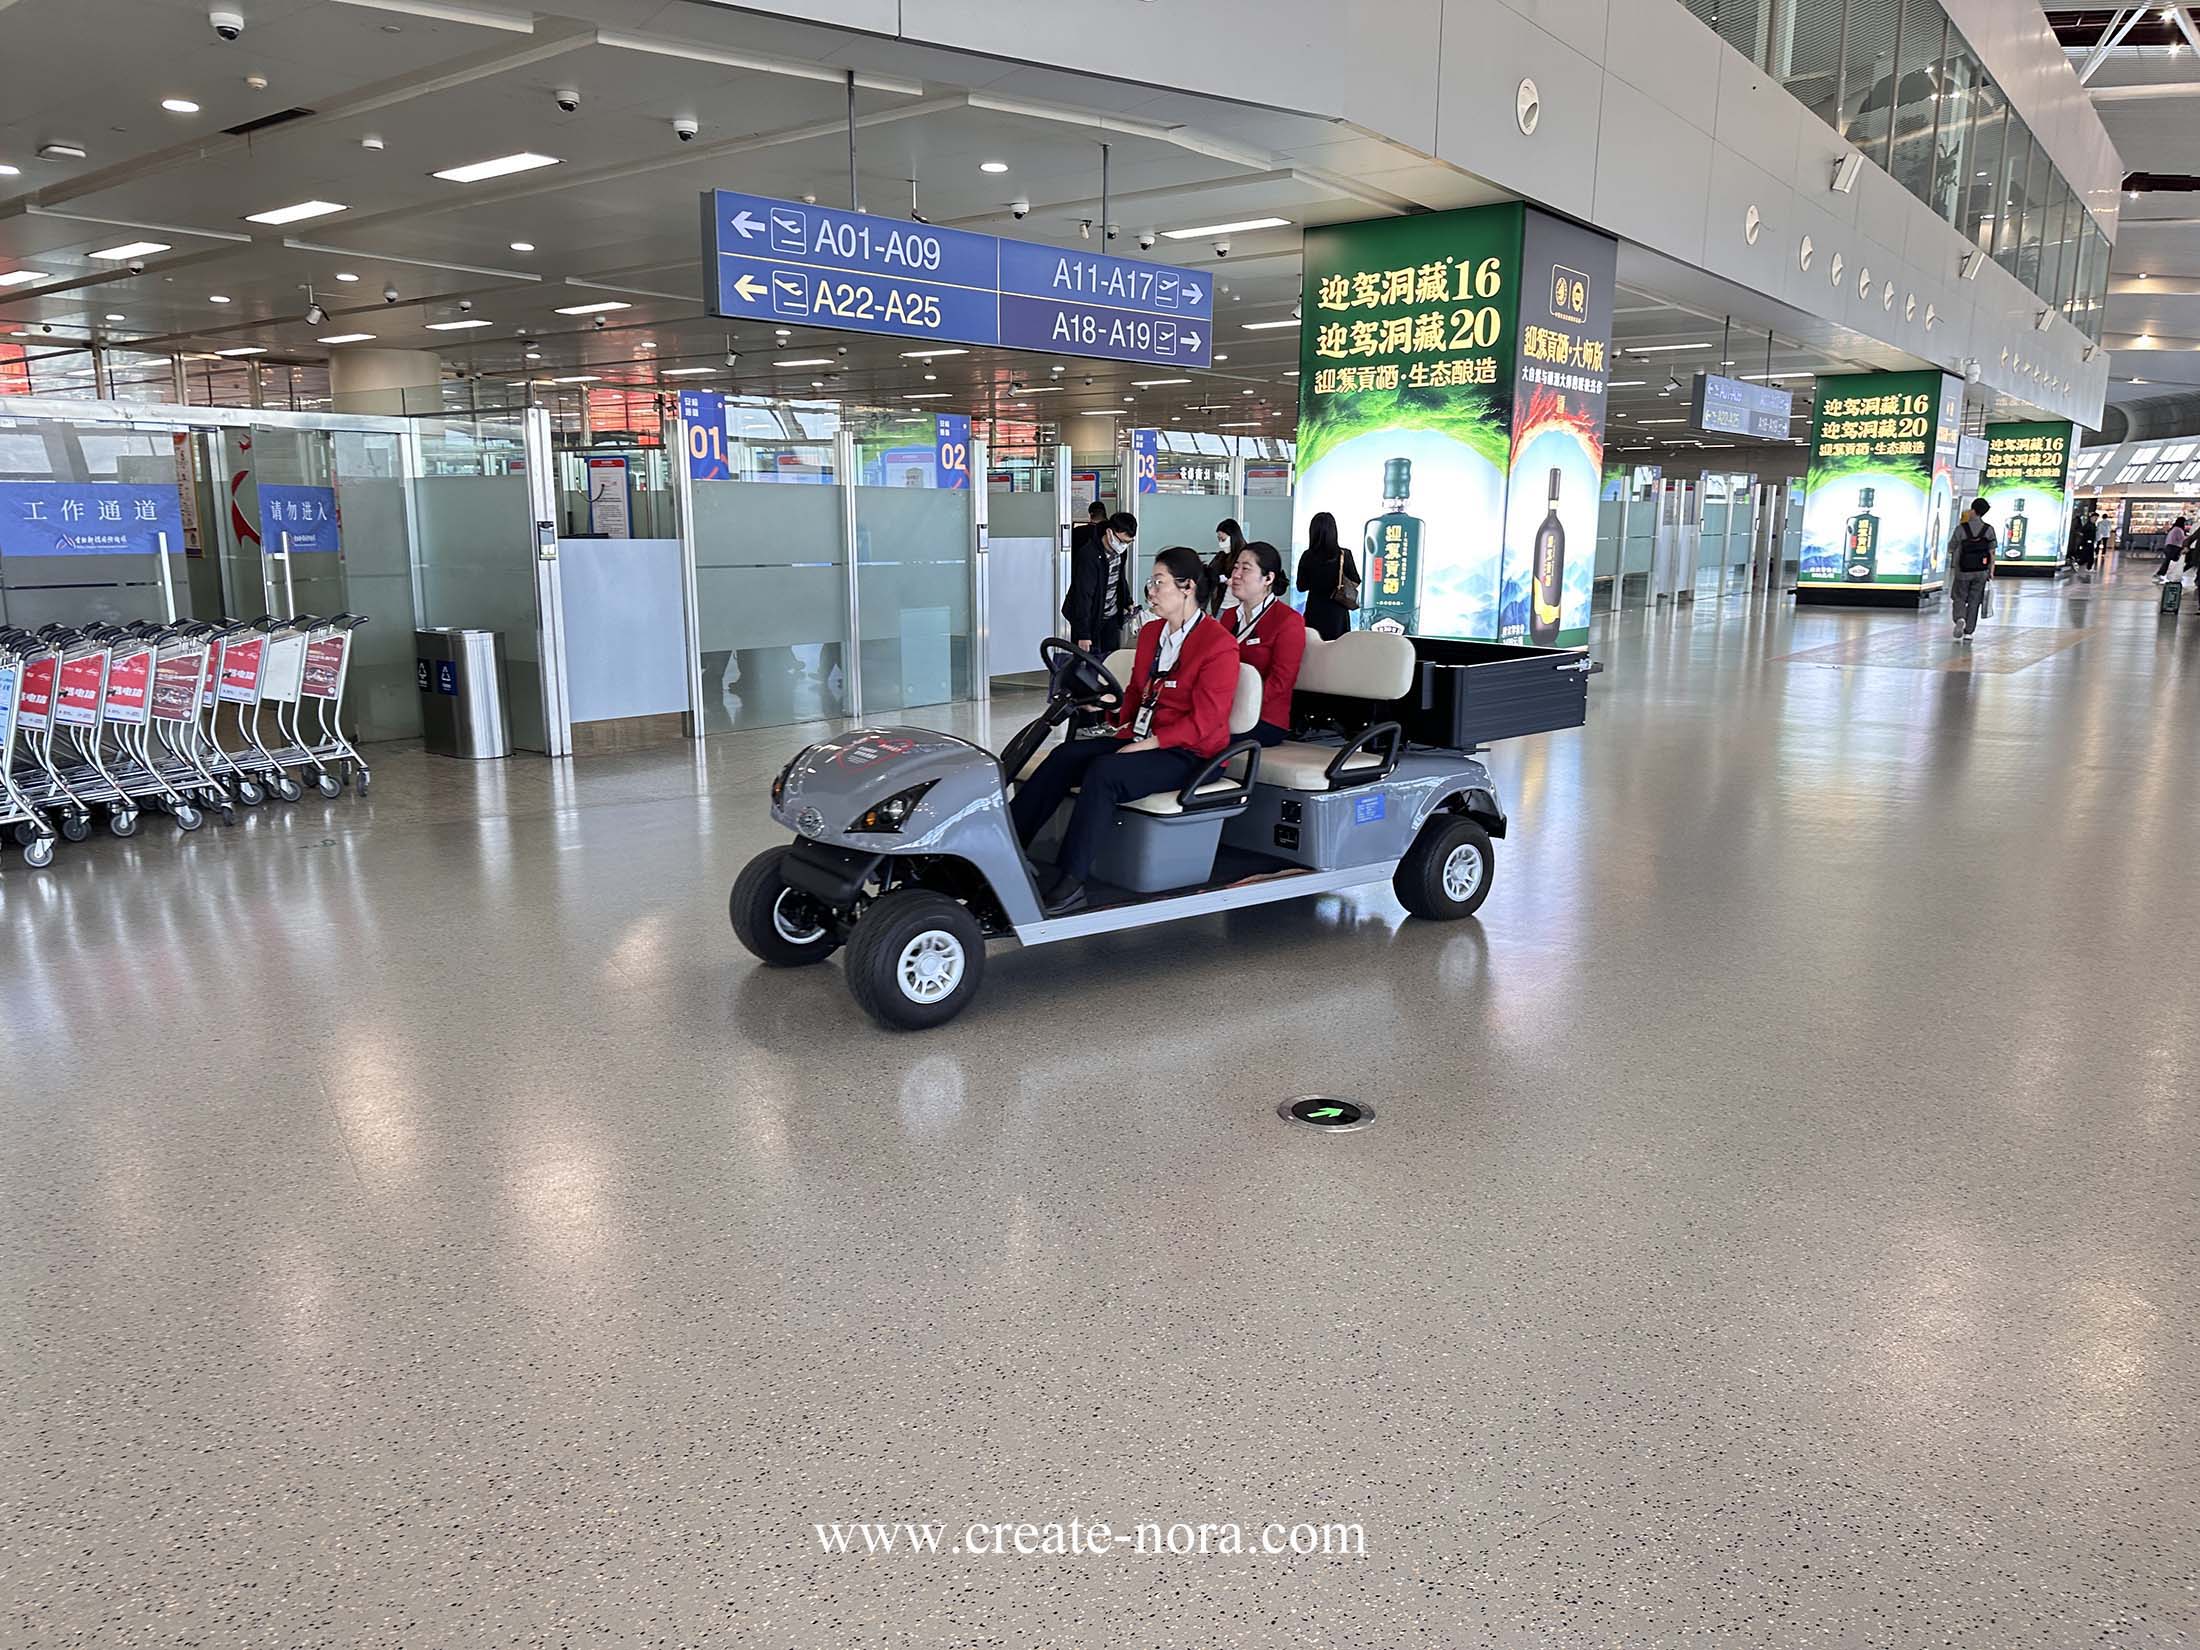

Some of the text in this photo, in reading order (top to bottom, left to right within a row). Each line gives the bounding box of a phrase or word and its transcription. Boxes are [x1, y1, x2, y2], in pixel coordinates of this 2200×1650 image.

[814, 219, 942, 271] A01-A09
[1052, 258, 1154, 300] A11-A17
[813, 280, 942, 328] A22-A25
[1052, 311, 1151, 350] A18-A19
[689, 424, 721, 460] 01
[941, 443, 966, 470] 02
[1139, 454, 1155, 479] 03
[23, 499, 158, 521] 工作通道
[270, 500, 328, 521] 请勿进入
